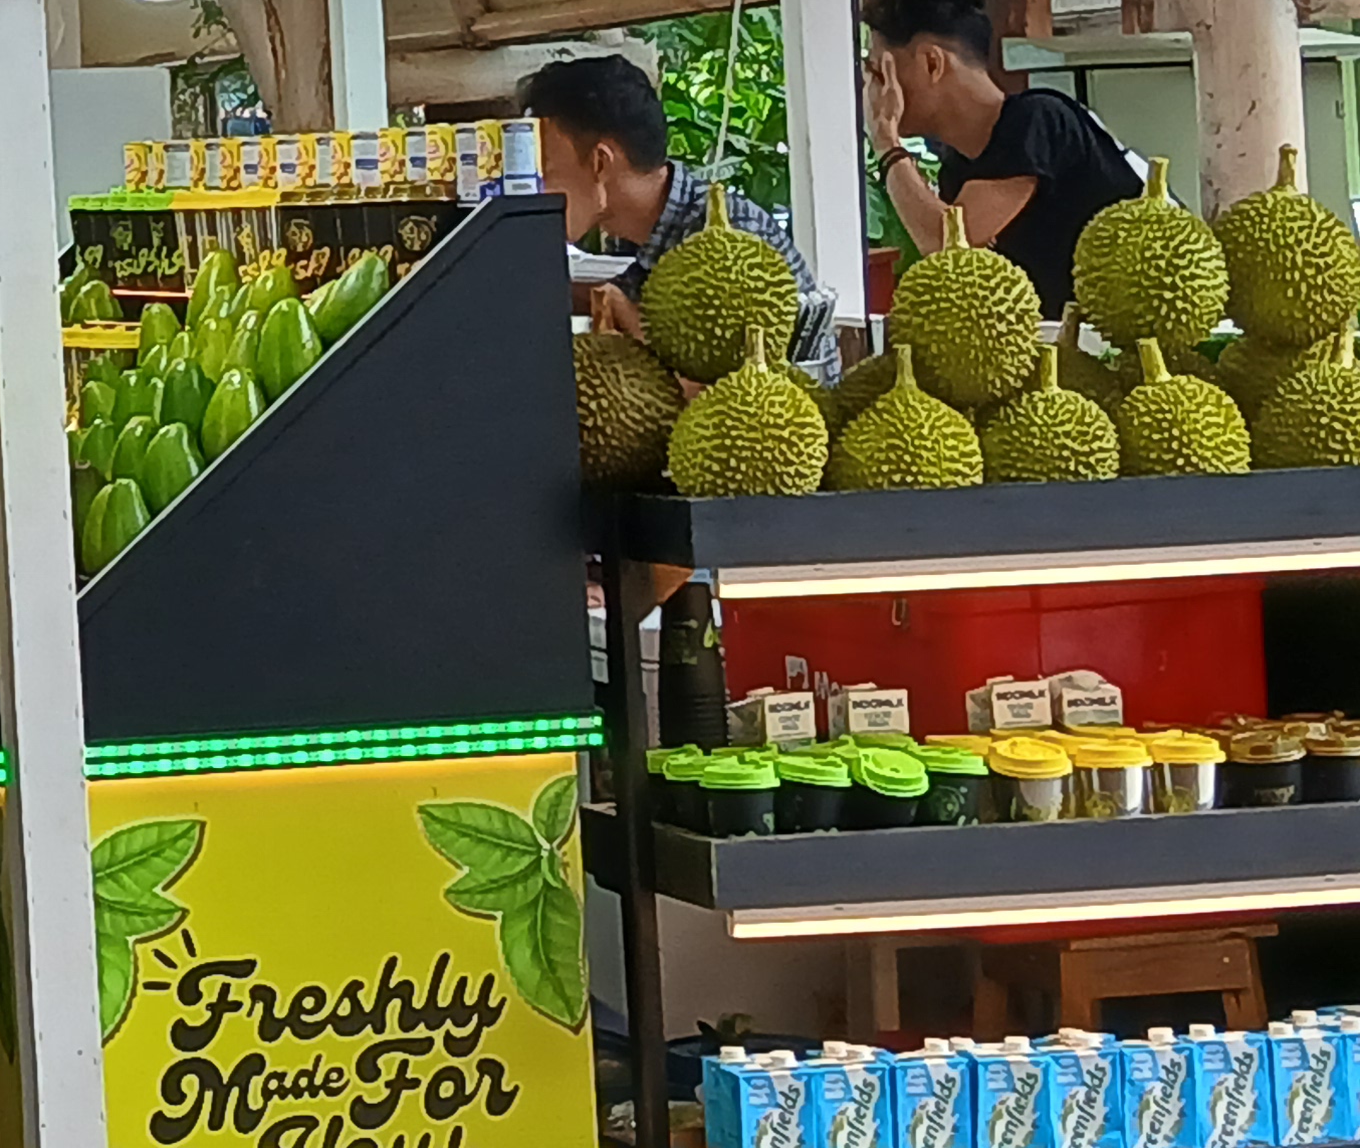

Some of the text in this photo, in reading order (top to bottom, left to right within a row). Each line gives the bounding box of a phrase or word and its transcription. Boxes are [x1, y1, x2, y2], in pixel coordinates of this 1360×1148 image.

[170, 952, 508, 1059] Freshly
[149, 1036, 521, 1145] Made For
